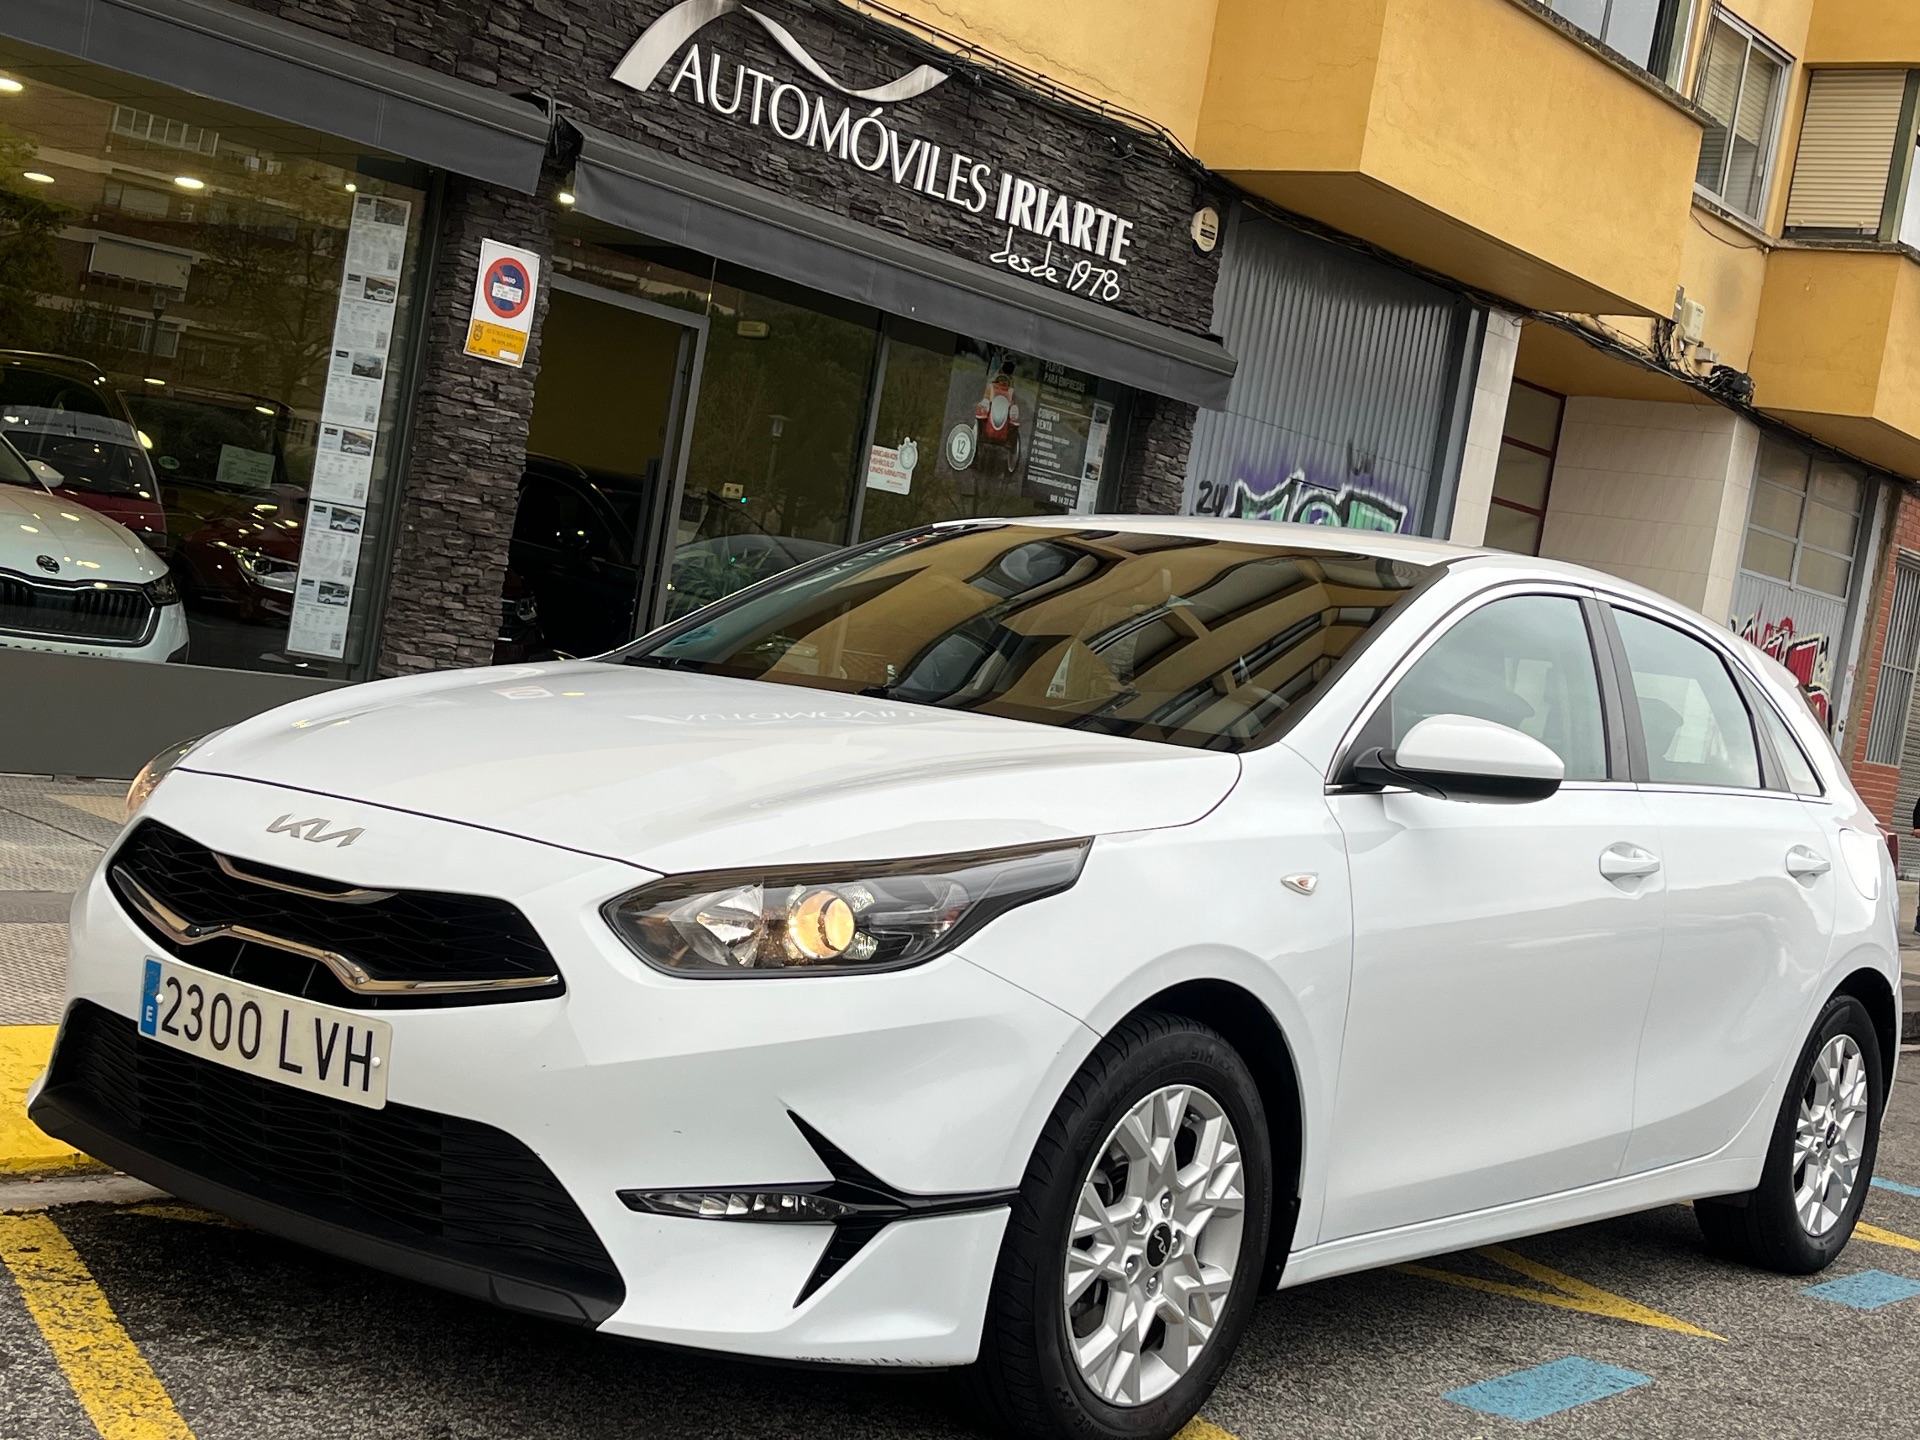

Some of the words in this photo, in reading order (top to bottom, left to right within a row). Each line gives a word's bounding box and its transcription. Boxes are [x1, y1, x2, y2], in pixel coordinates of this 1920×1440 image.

[668, 43, 991, 213] AUTOMÓVILES
[995, 172, 1133, 266] IRIARTE
[989, 226, 1059, 283] desde
[1066, 260, 1120, 301] 1978
[1036, 418, 1053, 432] VENTA
[1038, 407, 1060, 422] COMPRA
[956, 439, 966, 455] 12
[266, 813, 367, 848] KIA
[145, 1005, 154, 1022] E
[161, 976, 262, 1060] 2300
[279, 1009, 373, 1092] LVH
